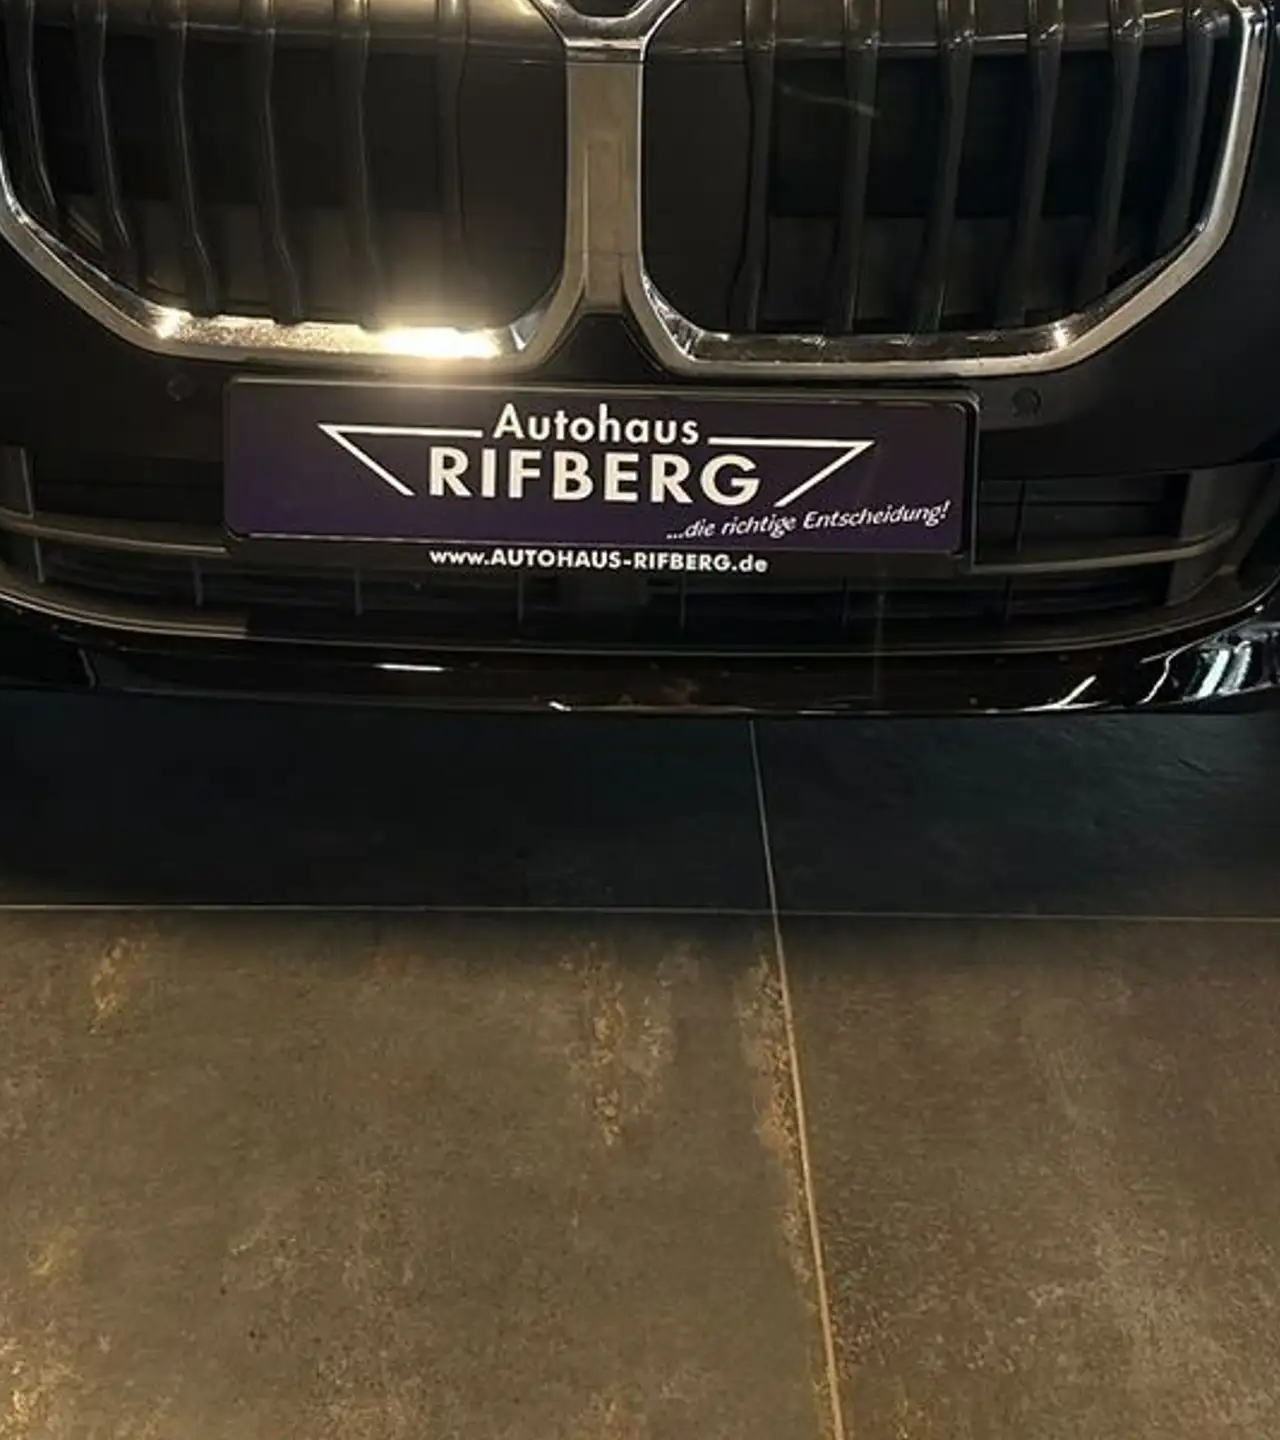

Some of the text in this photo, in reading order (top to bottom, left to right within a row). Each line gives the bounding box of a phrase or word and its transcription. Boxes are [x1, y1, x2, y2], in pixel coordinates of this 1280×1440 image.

[493, 403, 699, 445] Autohaus
[429, 446, 761, 506] RIFBERG
[666, 500, 951, 539] ...die richtige Entscheidung!
[429, 548, 769, 573] www.AUTOHAUS-RIFBERG.de
